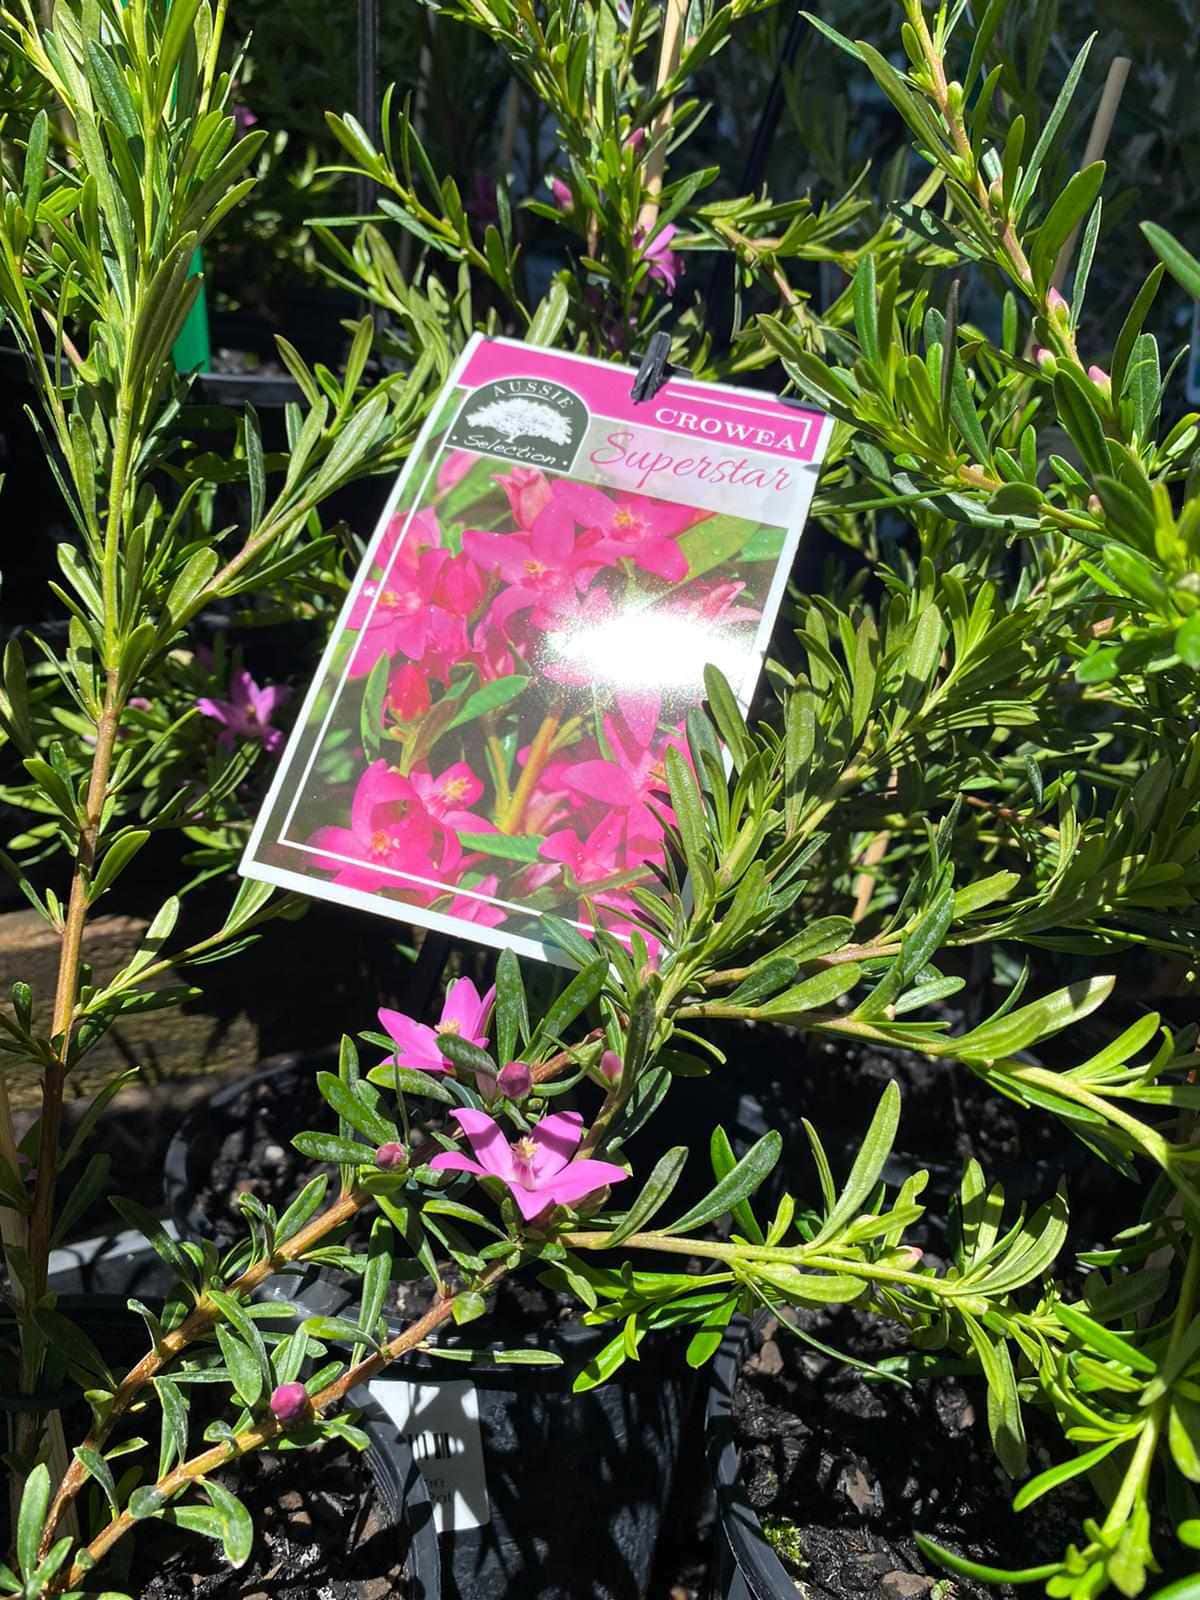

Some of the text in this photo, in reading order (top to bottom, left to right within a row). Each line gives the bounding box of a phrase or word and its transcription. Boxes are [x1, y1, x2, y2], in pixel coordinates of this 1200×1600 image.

[492, 380, 575, 409] AUSSIE
[654, 406, 797, 452] CROWEA
[464, 434, 557, 466] Selection
[590, 430, 793, 492] Superstar
